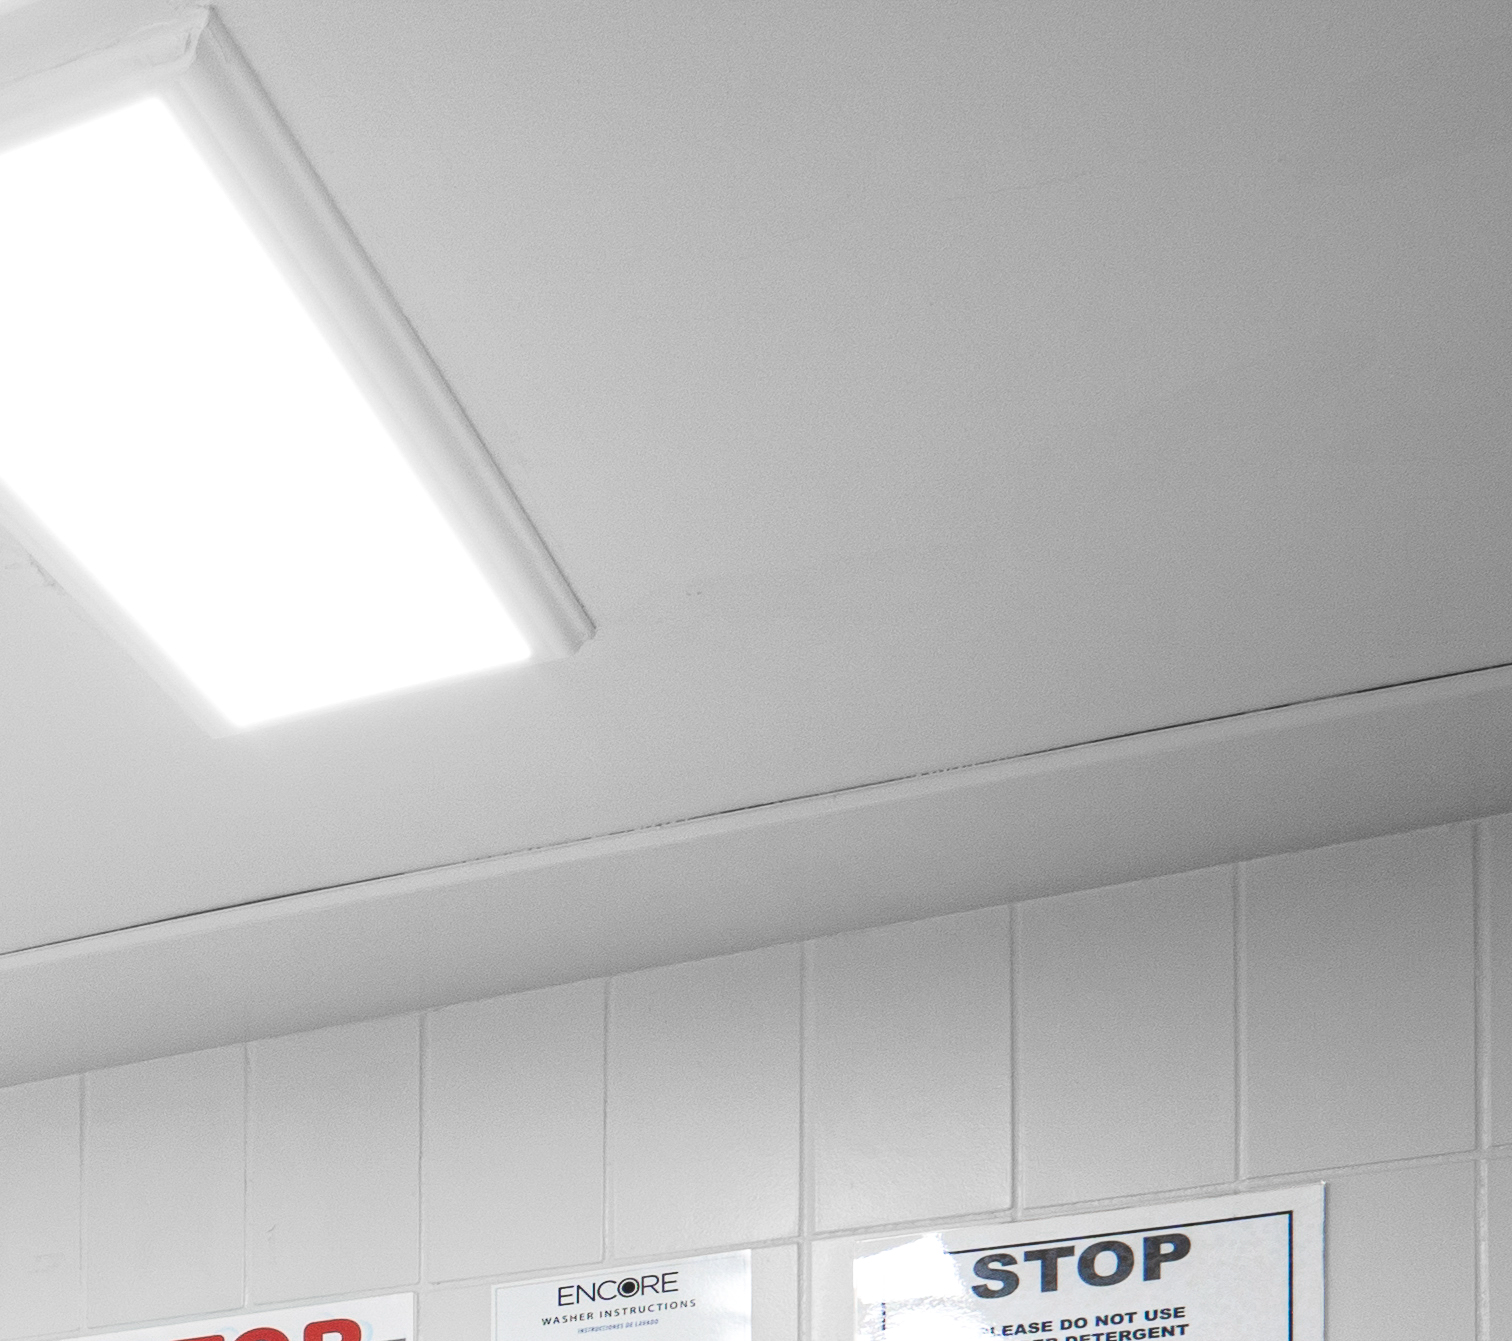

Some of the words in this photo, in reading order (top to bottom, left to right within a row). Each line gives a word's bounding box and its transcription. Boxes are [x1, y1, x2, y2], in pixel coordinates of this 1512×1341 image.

[971, 1232, 1192, 1300] STOP
[558, 1272, 679, 1306] ENCORE
[541, 1313, 594, 1325] WASHER
[599, 1299, 697, 1318] INSTRUCTIONS
[1060, 1317, 1088, 1330] DO
[1095, 1311, 1137, 1327] NOT
[1144, 1306, 1186, 1321] USE
